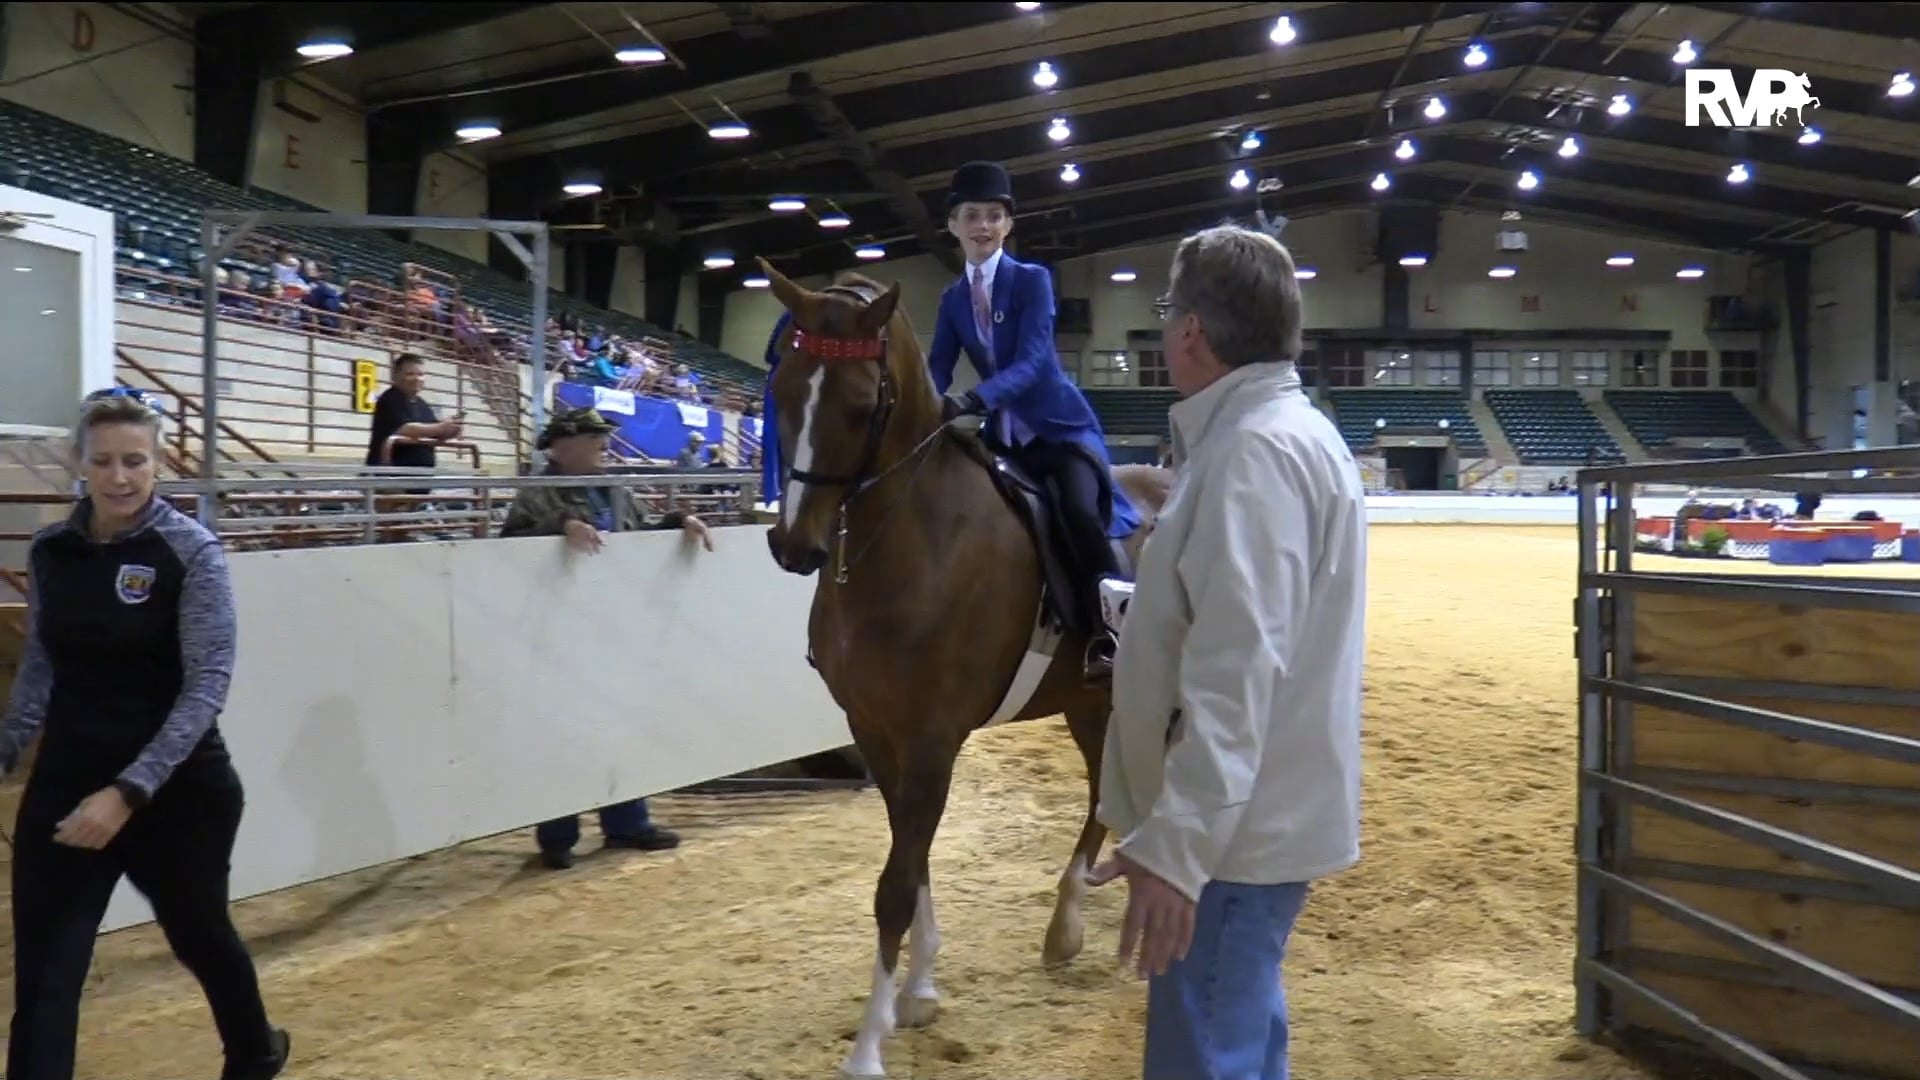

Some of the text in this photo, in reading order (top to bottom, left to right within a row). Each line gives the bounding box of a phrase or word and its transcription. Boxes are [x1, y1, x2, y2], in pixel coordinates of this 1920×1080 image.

[73, 10, 95, 51] D
[286, 133, 302, 170] E
[1424, 294, 1438, 313] L
